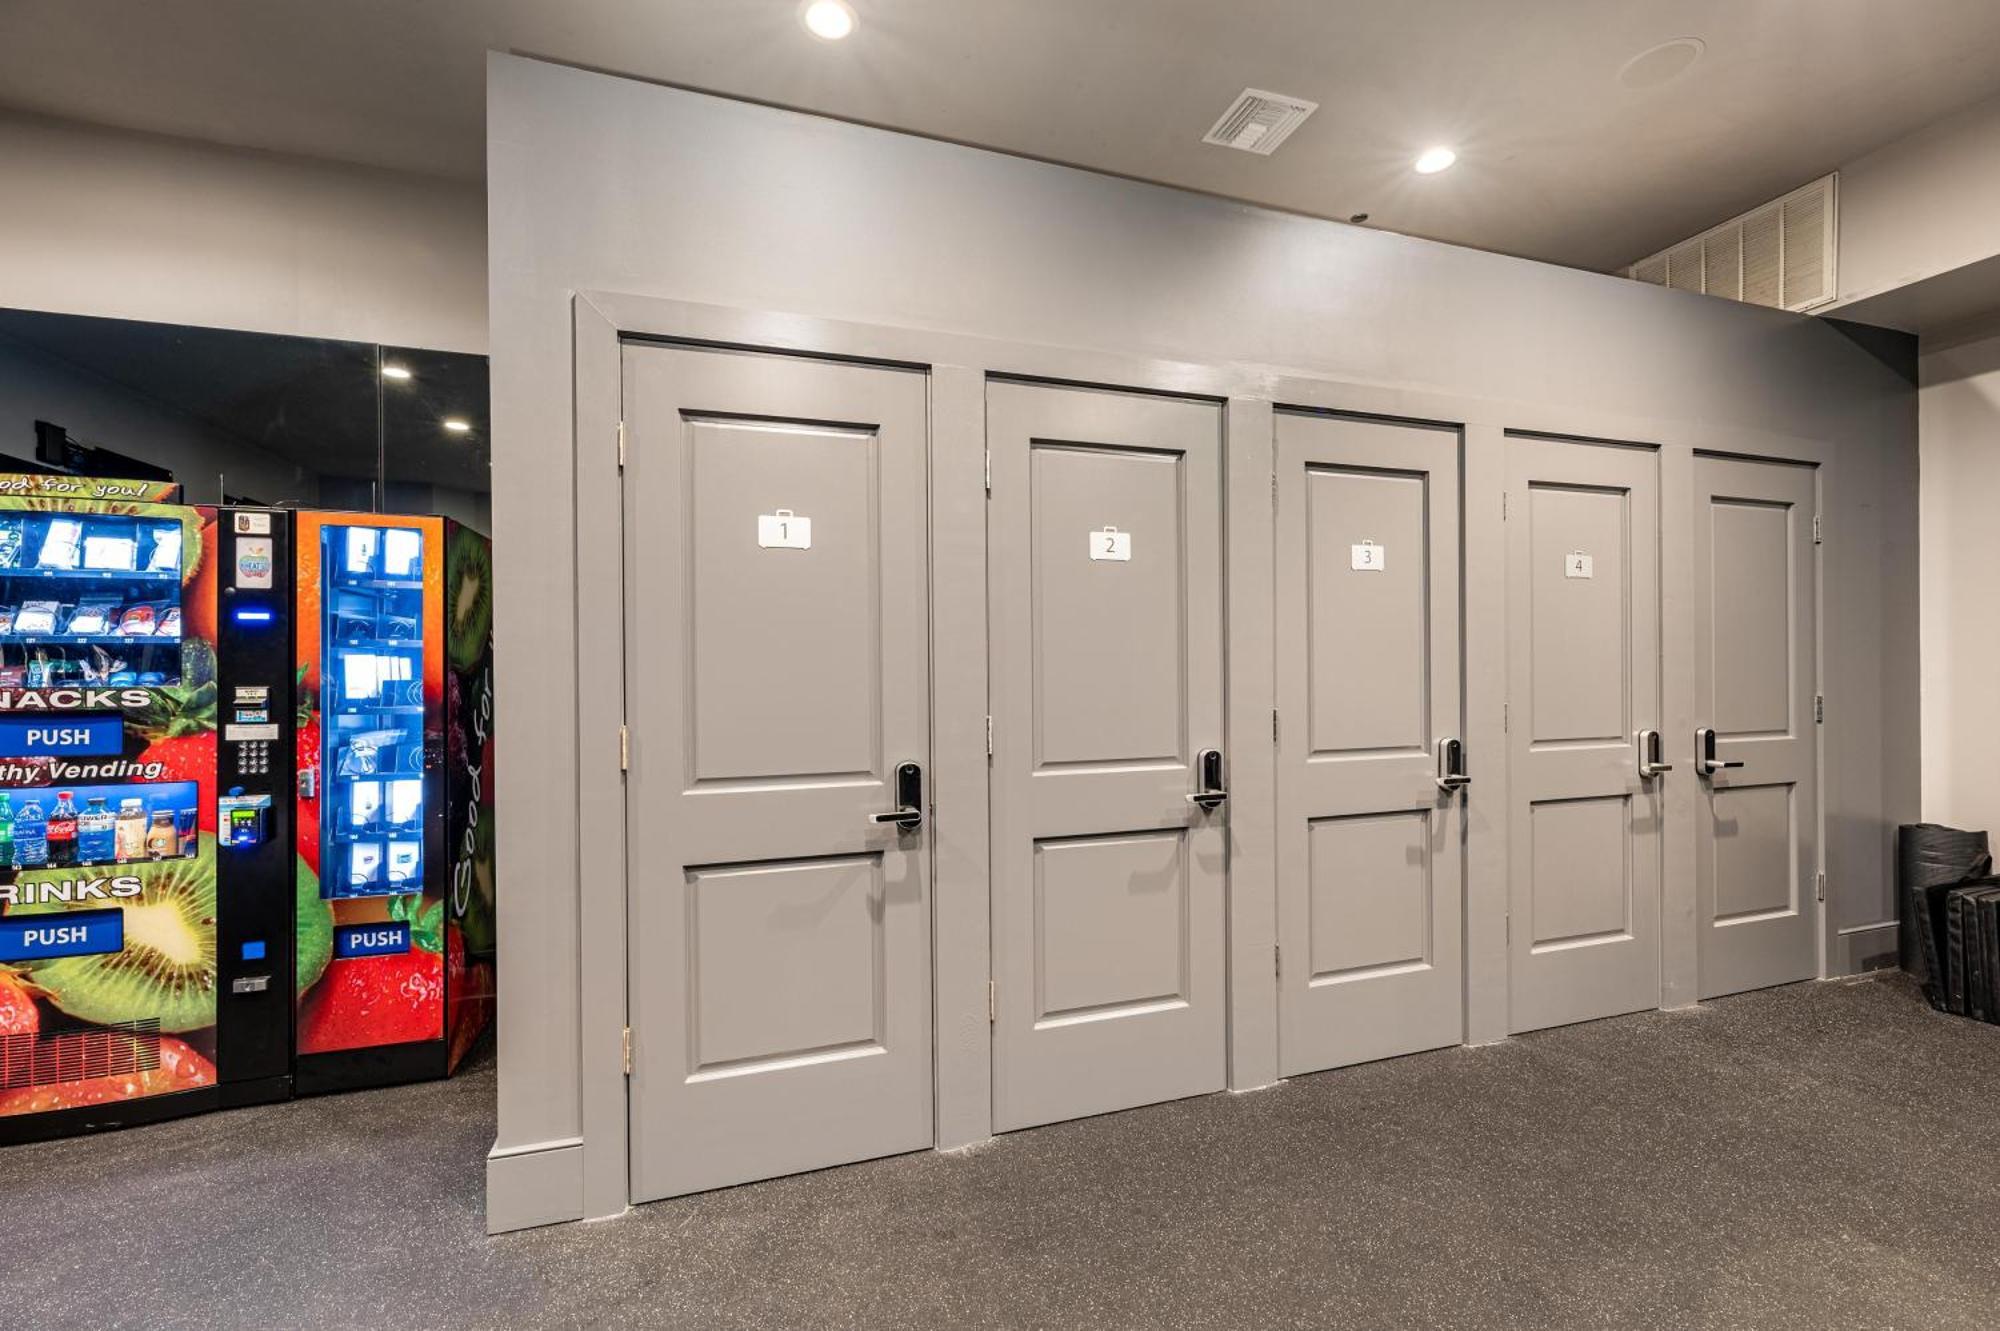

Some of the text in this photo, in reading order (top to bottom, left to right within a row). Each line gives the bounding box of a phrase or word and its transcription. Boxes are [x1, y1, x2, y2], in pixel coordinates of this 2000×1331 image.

[41, 478, 81, 490] for
[93, 483, 148, 497] you!
[780, 522, 787, 540] 1
[1104, 537, 1115, 553] 2
[1364, 550, 1372, 564] 3
[1575, 559, 1582, 572] 4
[27, 729, 90, 746] PUSH
[49, 760, 163, 778] Vending
[454, 765, 482, 917] Good
[24, 926, 87, 947] PUSH
[351, 930, 402, 949] PUSH
